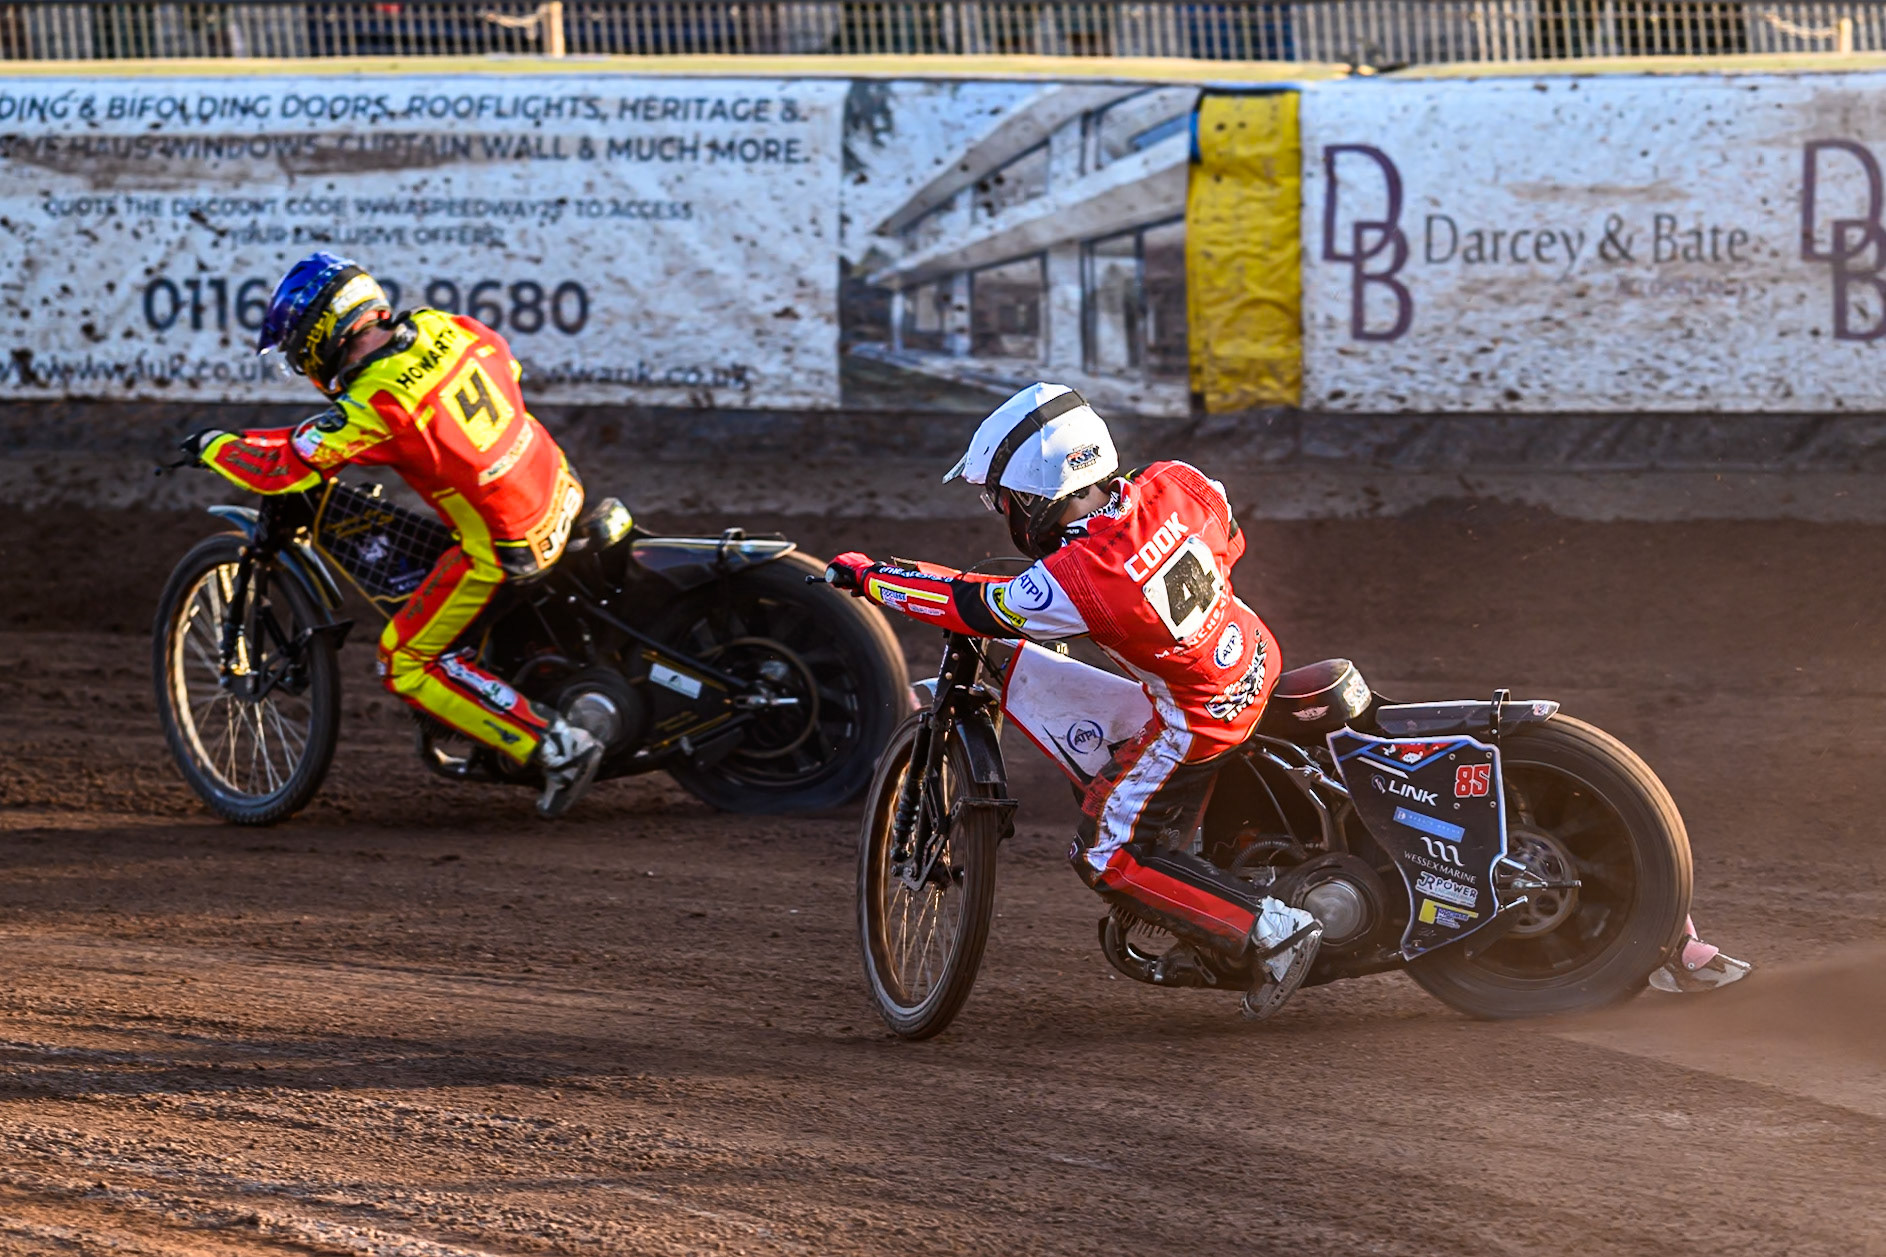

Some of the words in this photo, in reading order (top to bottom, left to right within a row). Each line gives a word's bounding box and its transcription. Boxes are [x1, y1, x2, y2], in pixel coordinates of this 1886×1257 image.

[78, 95, 97, 119] &
[107, 95, 271, 120] BIFOLDING
[618, 97, 771, 122] HERITAGE
[338, 134, 471, 157] CURTAIN
[481, 135, 567, 160] WALL
[577, 137, 596, 160] &
[607, 137, 698, 162] MUCH
[285, 198, 346, 216] CODE
[1424, 213, 1585, 283] Darcey
[1597, 213, 1636, 263] &
[1653, 213, 1750, 264] Bate
[142, 277, 268, 332] 0116
[424, 279, 590, 335] 9680
[395, 329, 457, 390] HOWARTH
[455, 369, 499, 426] 4
[542, 486, 582, 560] JCB
[1124, 511, 1189, 583] COOK
[1018, 574, 1043, 602] ATPI
[1163, 550, 1216, 627] 4
[1074, 728, 1098, 746] ATPI
[1389, 780, 1438, 806] LINK
[1455, 764, 1491, 798] 85
[1404, 851, 1440, 872] WESSEX
[1439, 865, 1477, 885] MARINE
[1418, 872, 1436, 890] JR
[1436, 879, 1477, 898] POWER
